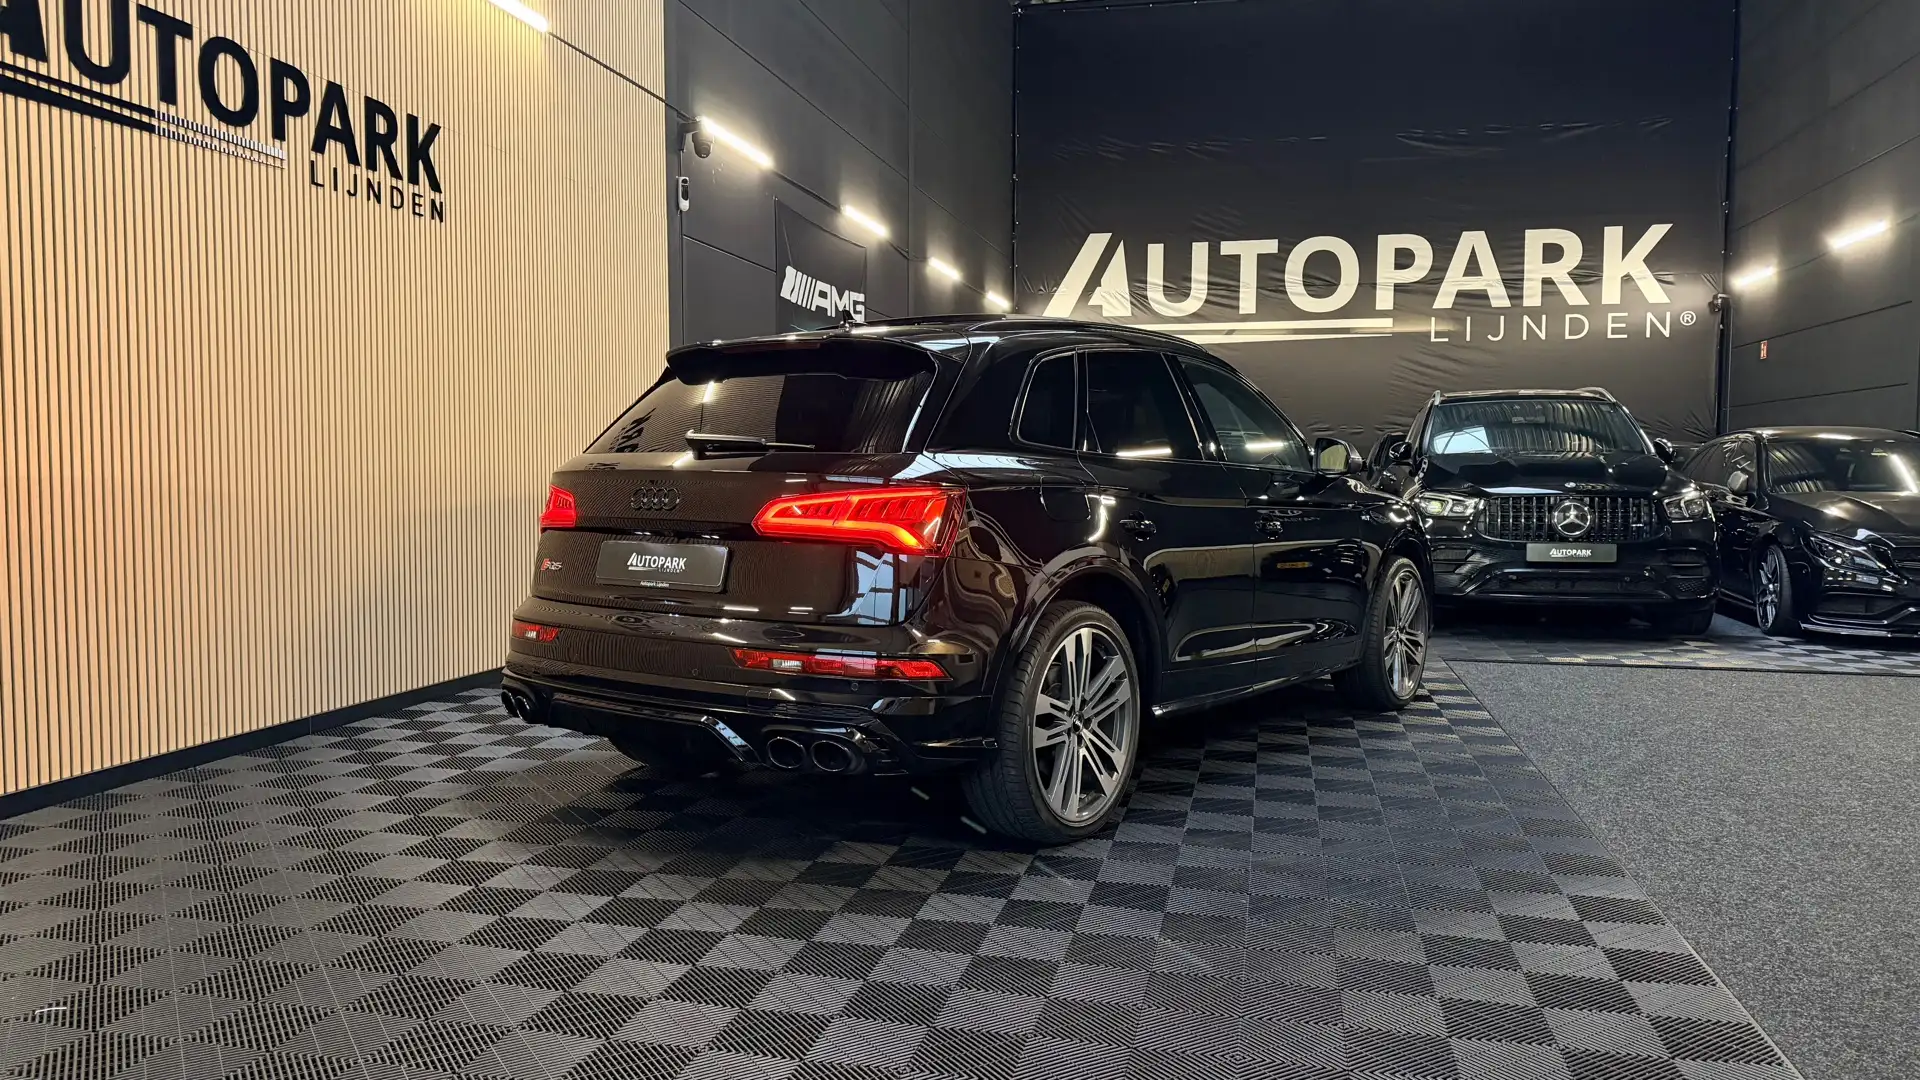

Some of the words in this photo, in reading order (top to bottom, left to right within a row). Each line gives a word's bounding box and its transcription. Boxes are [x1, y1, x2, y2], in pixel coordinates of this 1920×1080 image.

[310, 159, 444, 223] LIJNDEN
[1041, 223, 1673, 318] AUTOPARK
[626, 552, 687, 570] AUTOPARK
[1549, 548, 1592, 556] AUTOPARK
